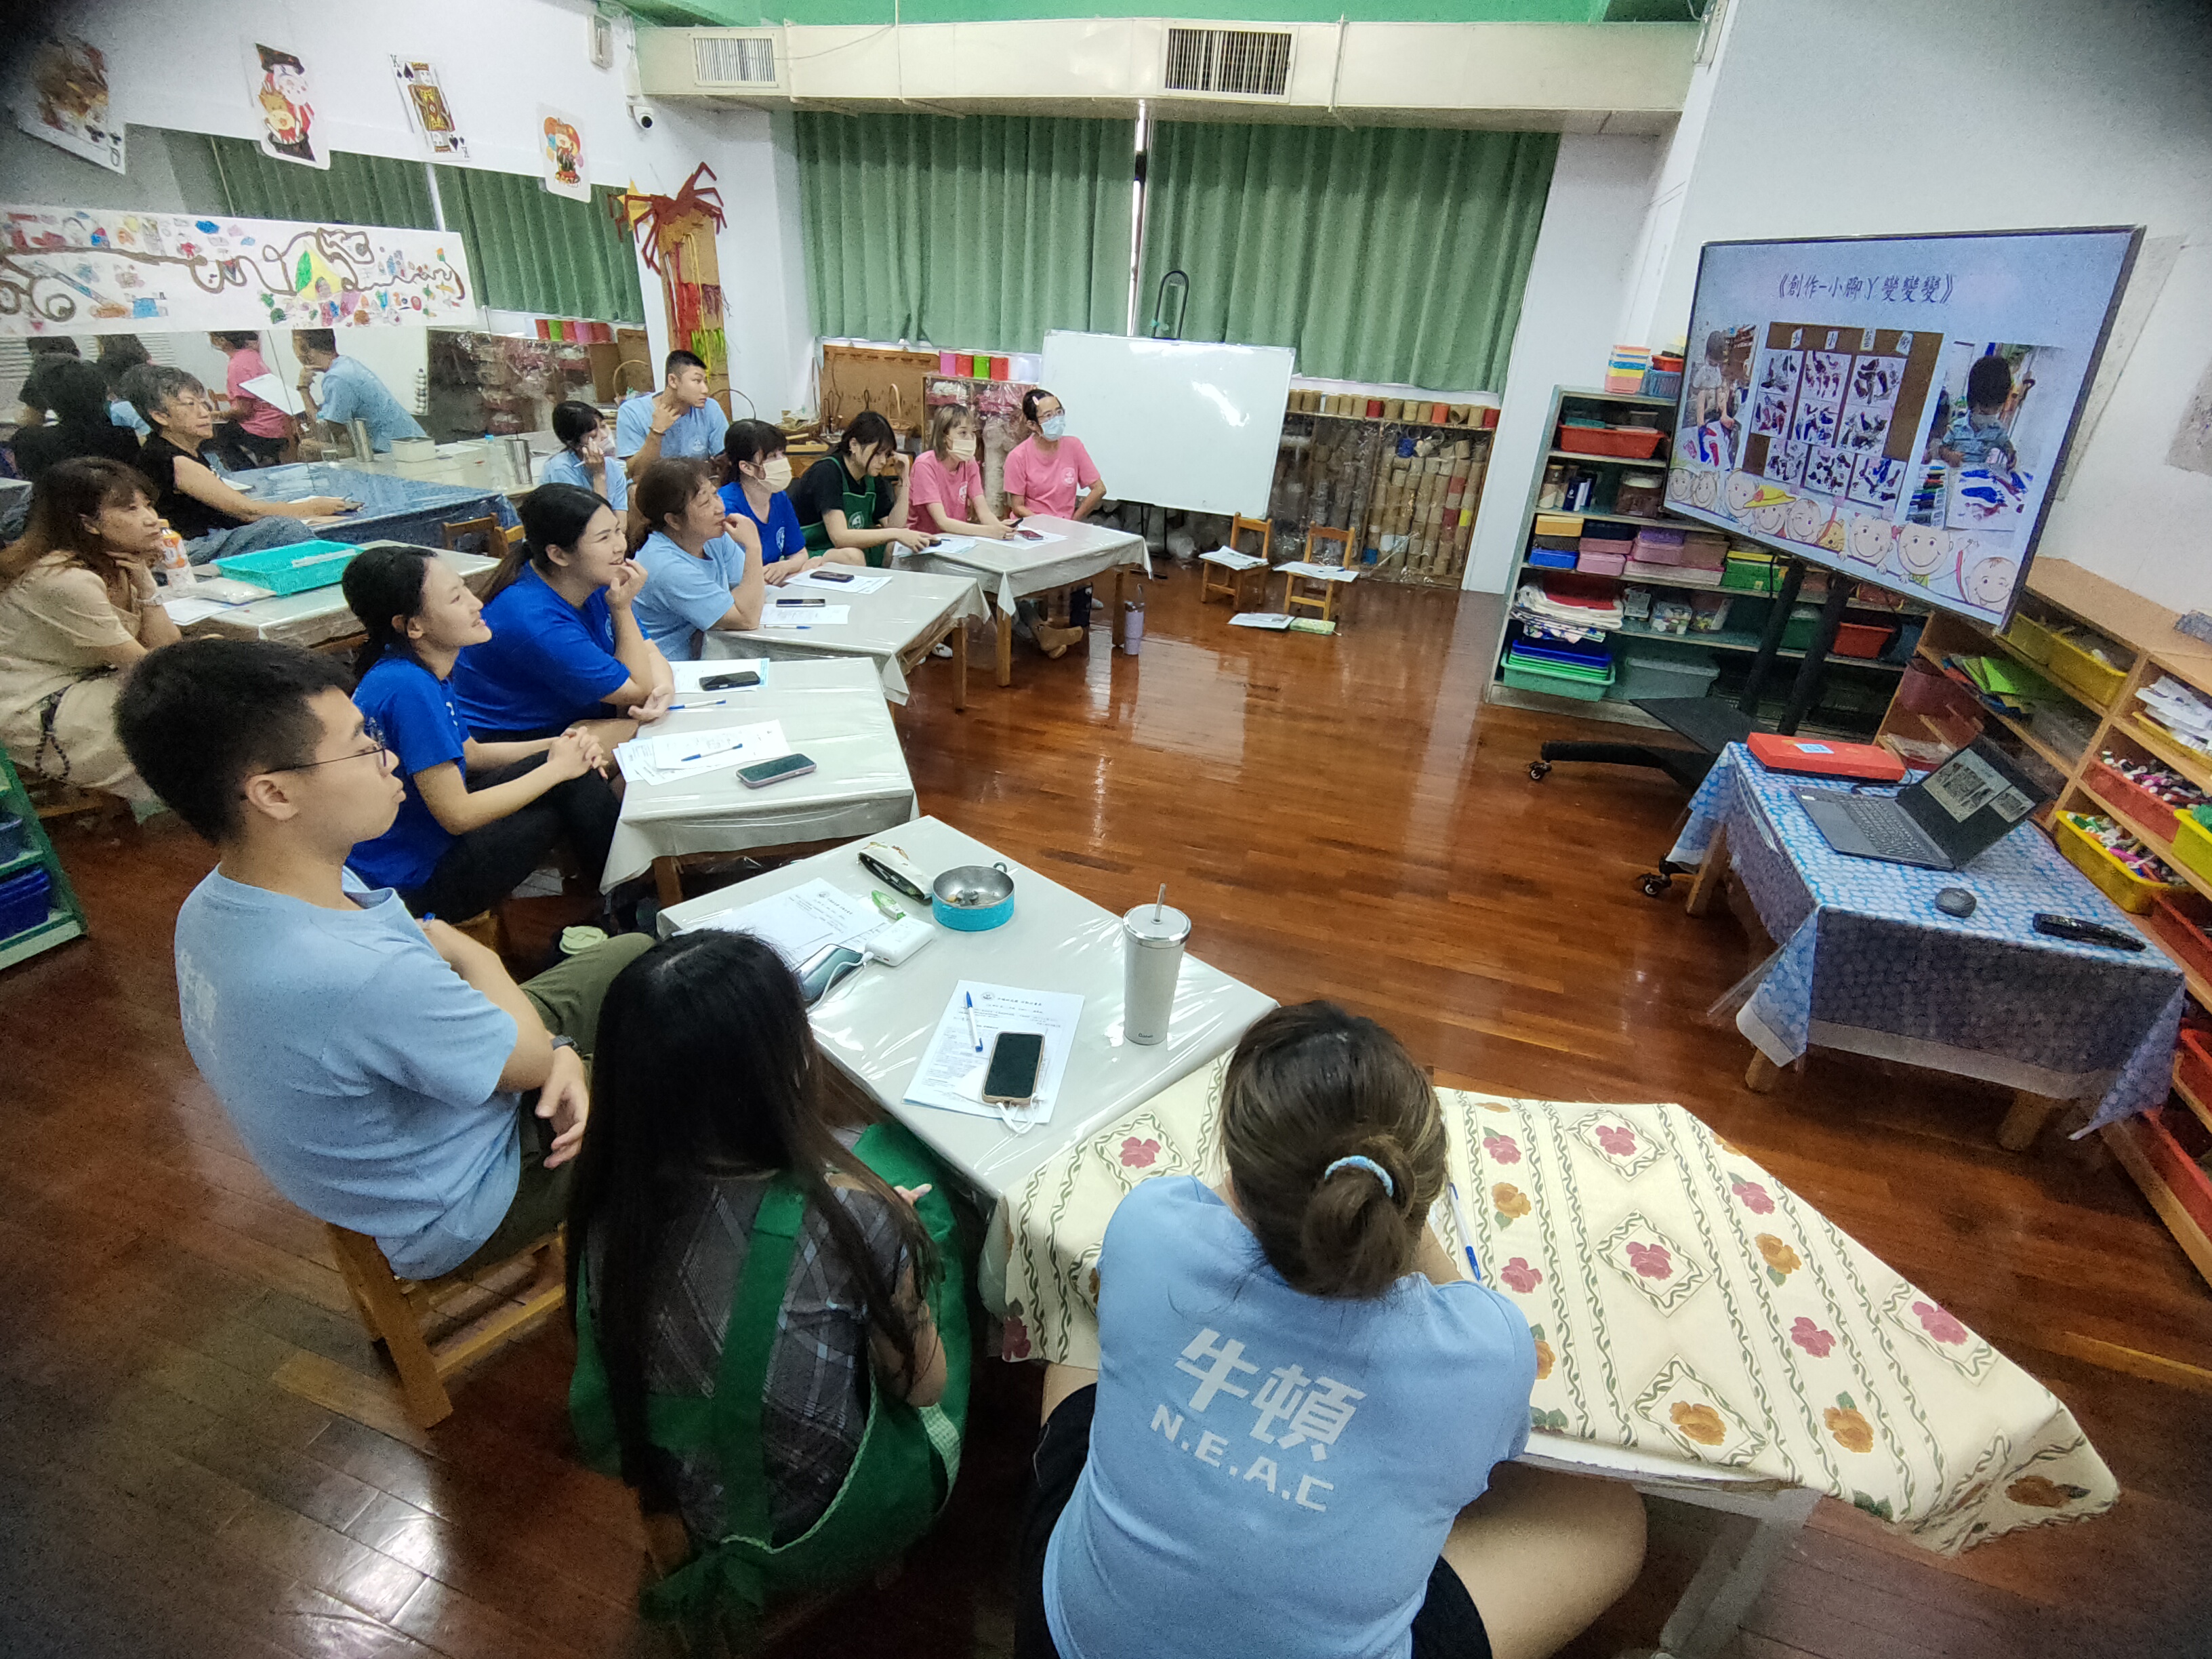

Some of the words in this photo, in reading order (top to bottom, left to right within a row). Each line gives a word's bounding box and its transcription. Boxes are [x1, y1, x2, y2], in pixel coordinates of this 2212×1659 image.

[390, 54, 401, 67] K
[1174, 1328, 1367, 1461] 牛頓
[1150, 1404, 1334, 1512] N.E.A.C
